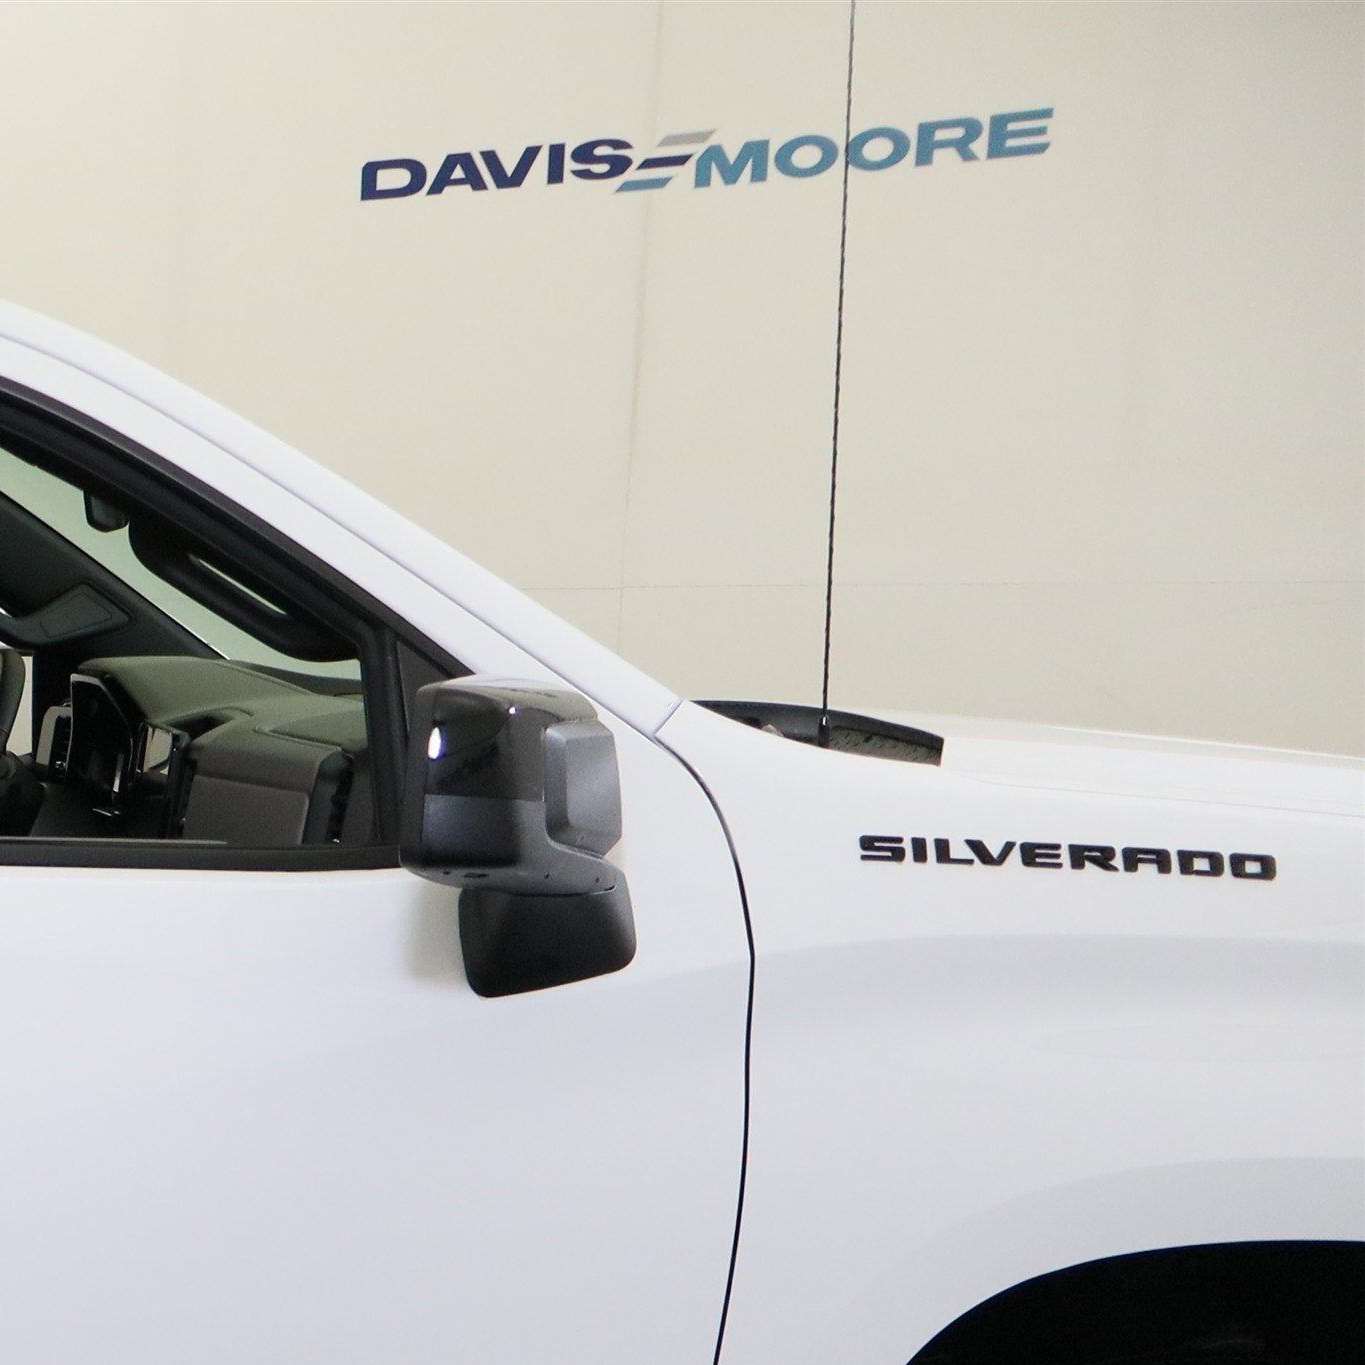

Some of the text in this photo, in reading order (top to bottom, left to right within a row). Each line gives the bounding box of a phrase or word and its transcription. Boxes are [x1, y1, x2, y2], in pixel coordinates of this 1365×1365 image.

[360, 107, 1054, 202] DAVIS MOORE
[859, 835, 1277, 881] SILVERADO
